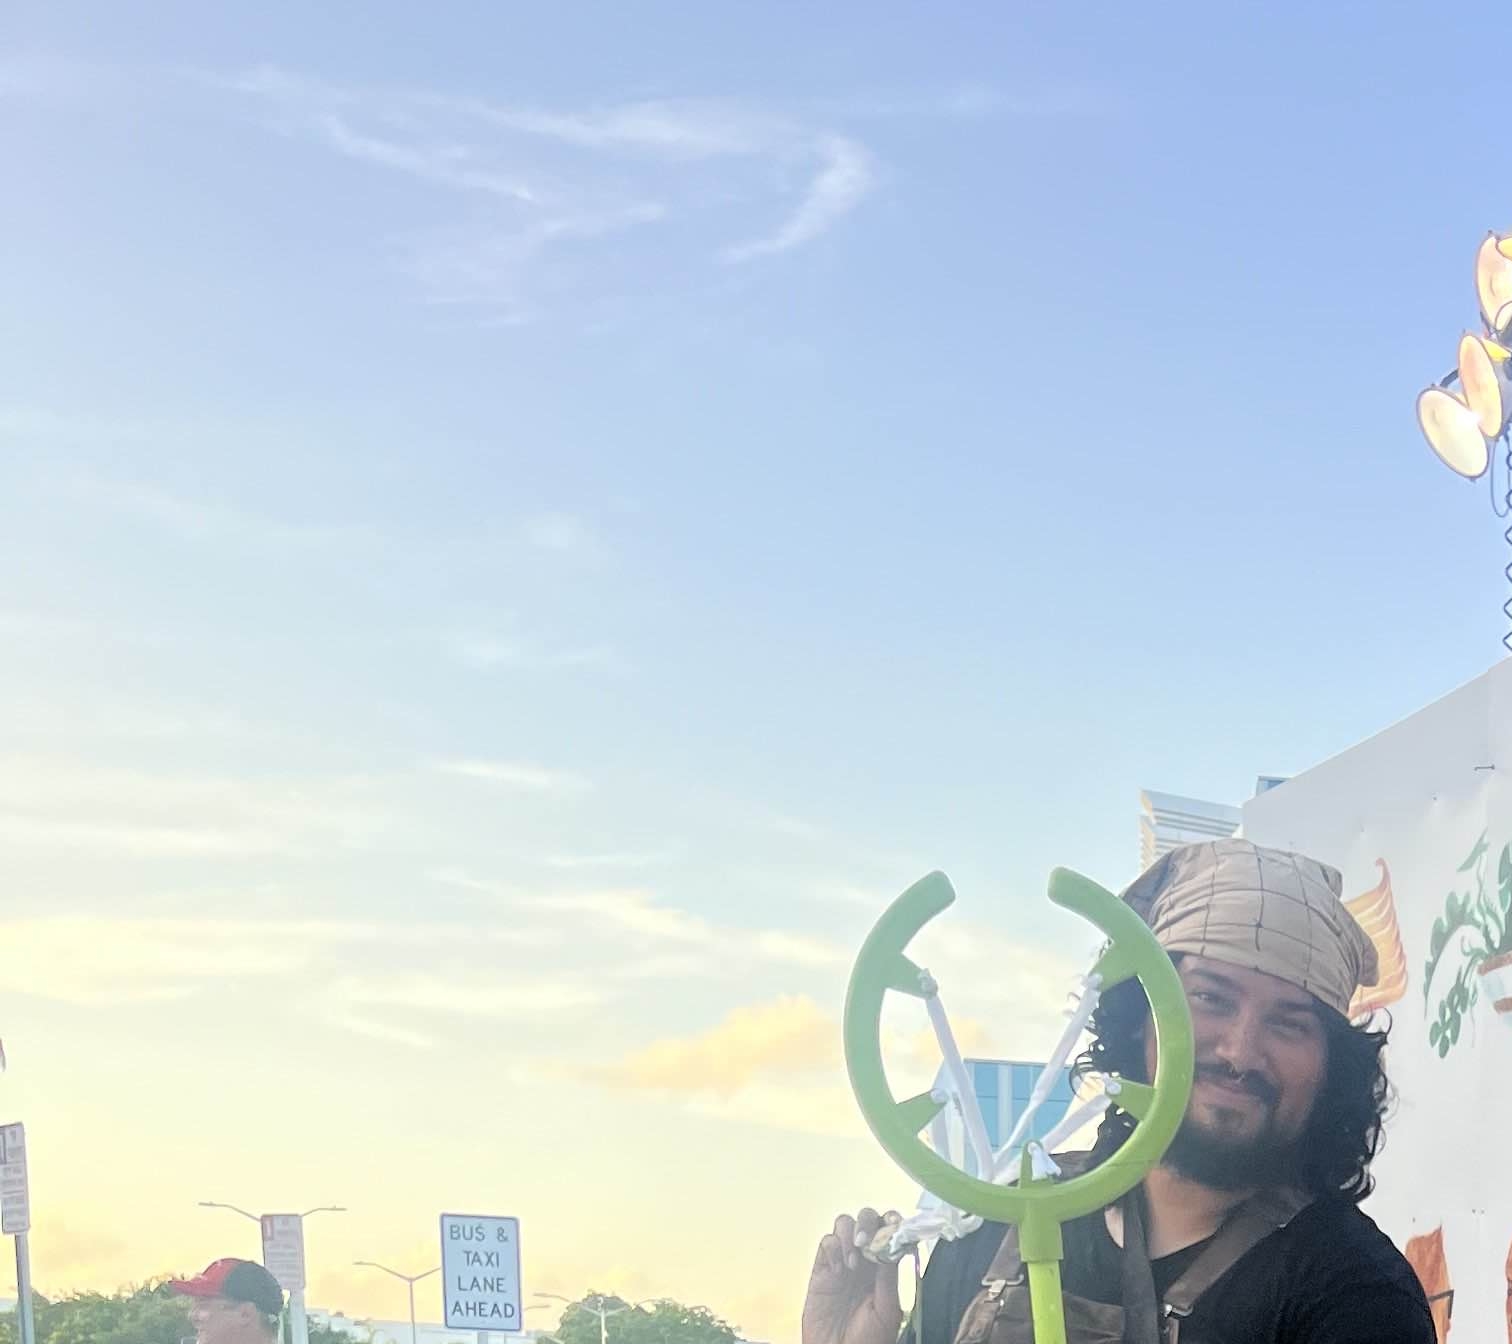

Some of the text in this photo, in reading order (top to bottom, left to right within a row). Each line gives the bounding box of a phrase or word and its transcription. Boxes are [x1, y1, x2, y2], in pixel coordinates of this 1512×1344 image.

[449, 1224, 509, 1242] BUS &
[463, 1250, 500, 1267] TAXI
[457, 1276, 506, 1293] LANE
[451, 1300, 515, 1318] AHEAD
